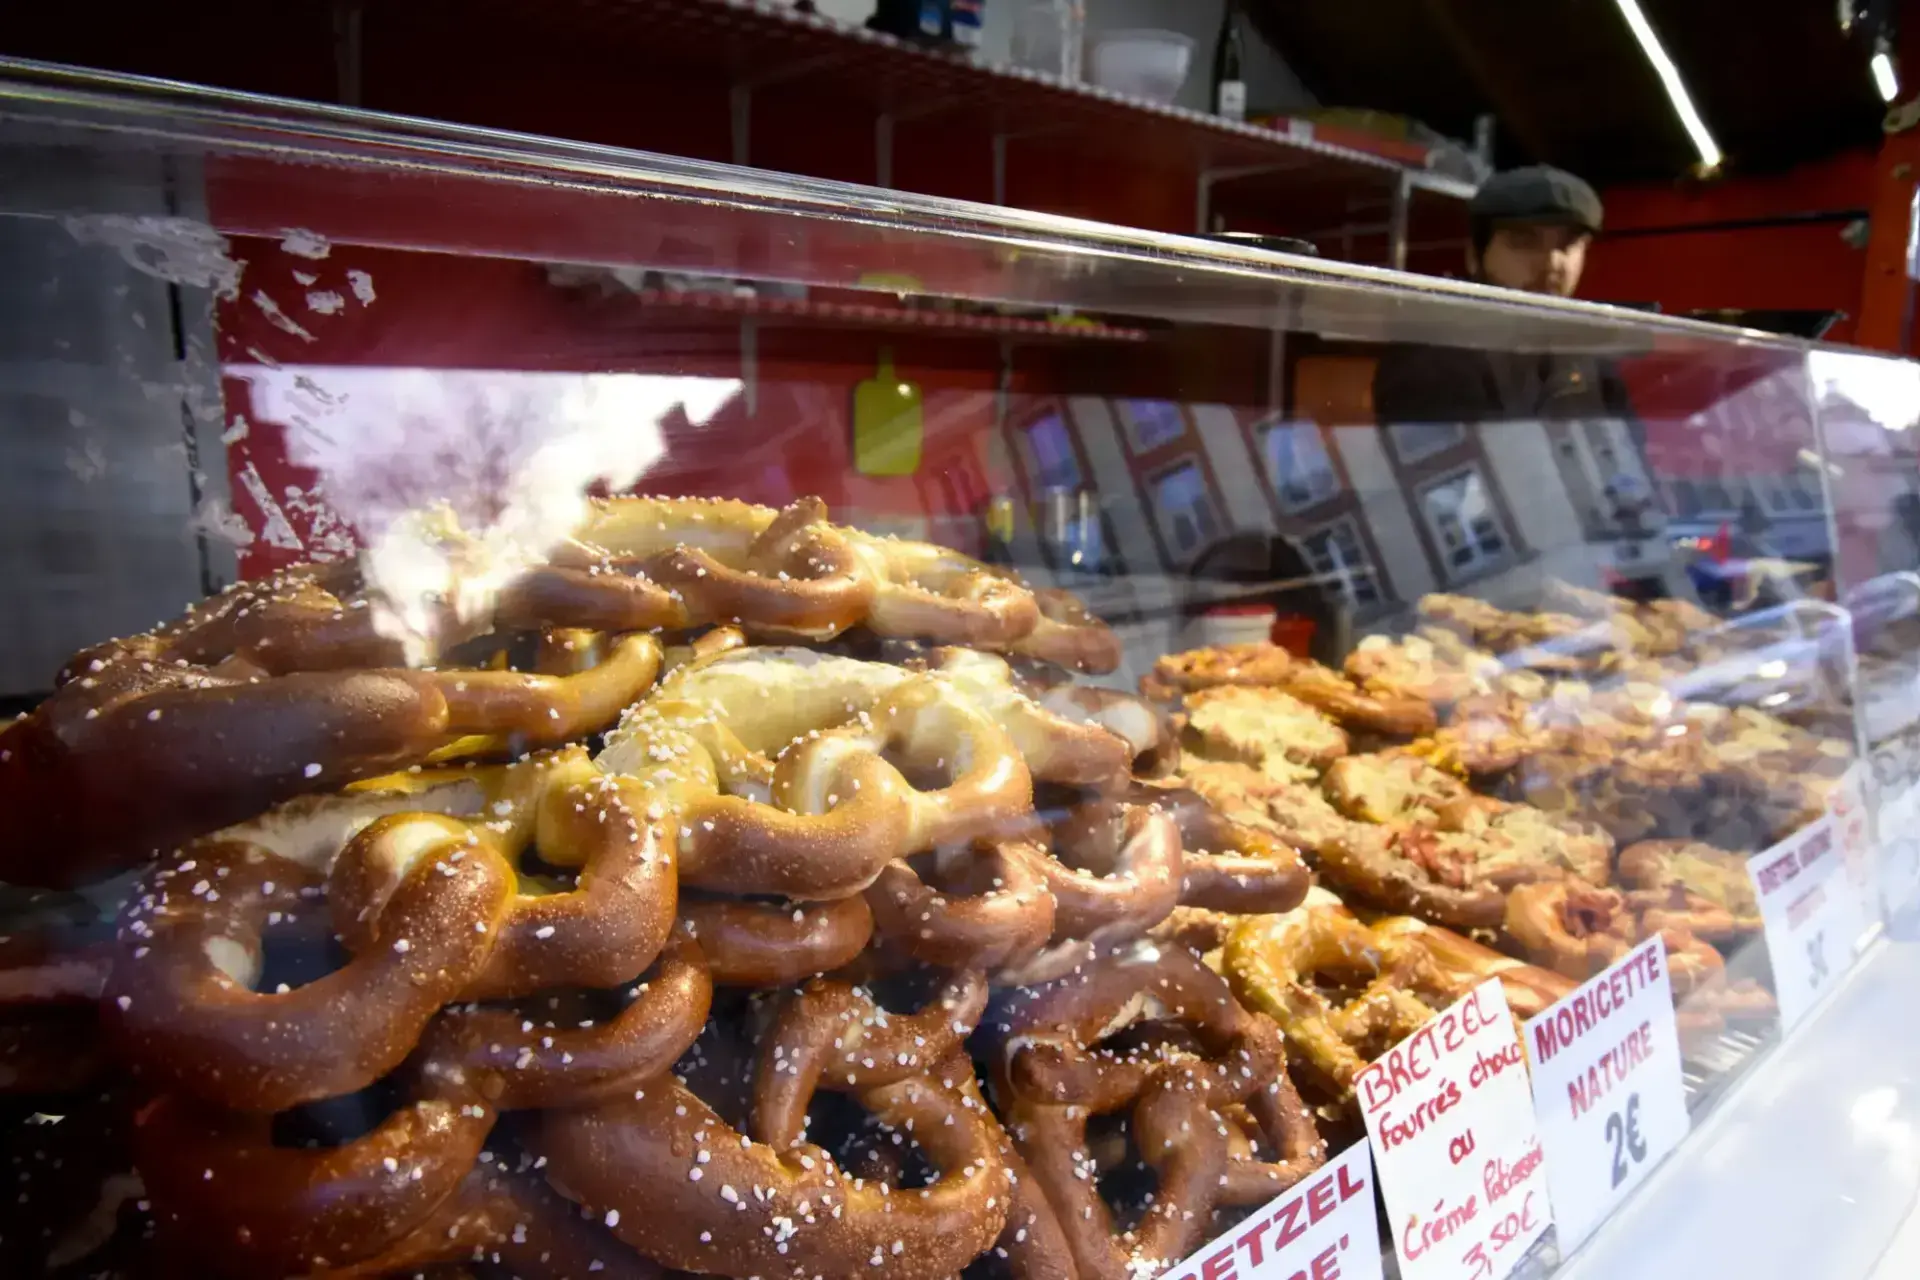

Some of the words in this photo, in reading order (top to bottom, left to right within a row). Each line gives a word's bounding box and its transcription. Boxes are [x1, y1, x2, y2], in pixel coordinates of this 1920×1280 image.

[1352, 991, 1499, 1114] BRETZEL
[1534, 944, 1660, 1065] MORICETTE
[1567, 1020, 1654, 1120] NATURE
[1449, 1128, 1475, 1165] ou
[1605, 1092, 1647, 1190] 2€
[1178, 1164, 1365, 1280] ETZEL
